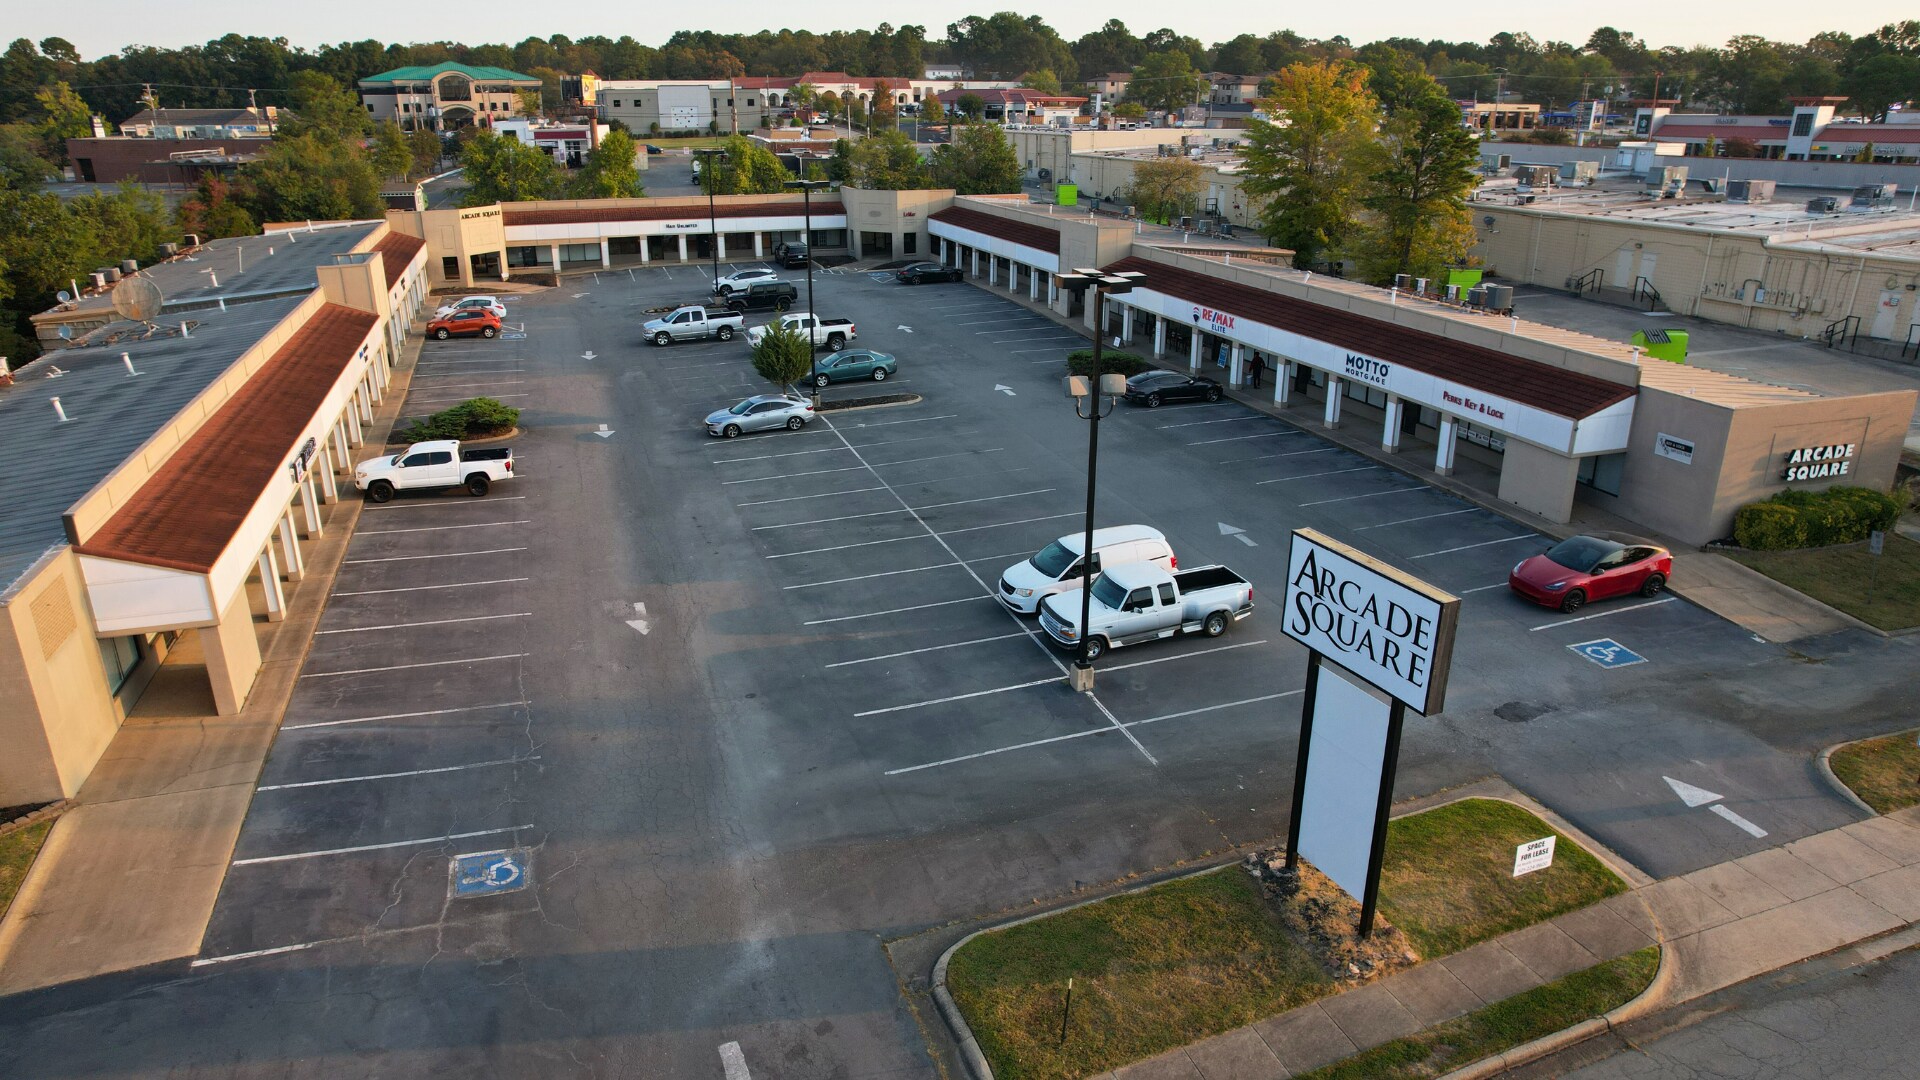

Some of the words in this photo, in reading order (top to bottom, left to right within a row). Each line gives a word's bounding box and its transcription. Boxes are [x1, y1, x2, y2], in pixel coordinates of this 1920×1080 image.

[1202, 308, 1235, 329] RE/MAX
[1211, 323, 1226, 333] ELITE
[1346, 353, 1389, 377] MOTTO
[1345, 367, 1386, 385] MORTGAGE
[1443, 390, 1463, 405] PERKS
[1464, 397, 1478, 410] KEY
[1479, 403, 1485, 413] &
[1486, 405, 1505, 419] LOCK
[1788, 444, 1855, 463] ARCADE
[1786, 461, 1850, 481] SQUARE
[1291, 548, 1431, 651] ARCADE
[1292, 591, 1426, 688] SQUARE
[1521, 852, 1532, 861] FOR
[1532, 847, 1549, 858] LEASE
[1527, 841, 1545, 851] SPACE
